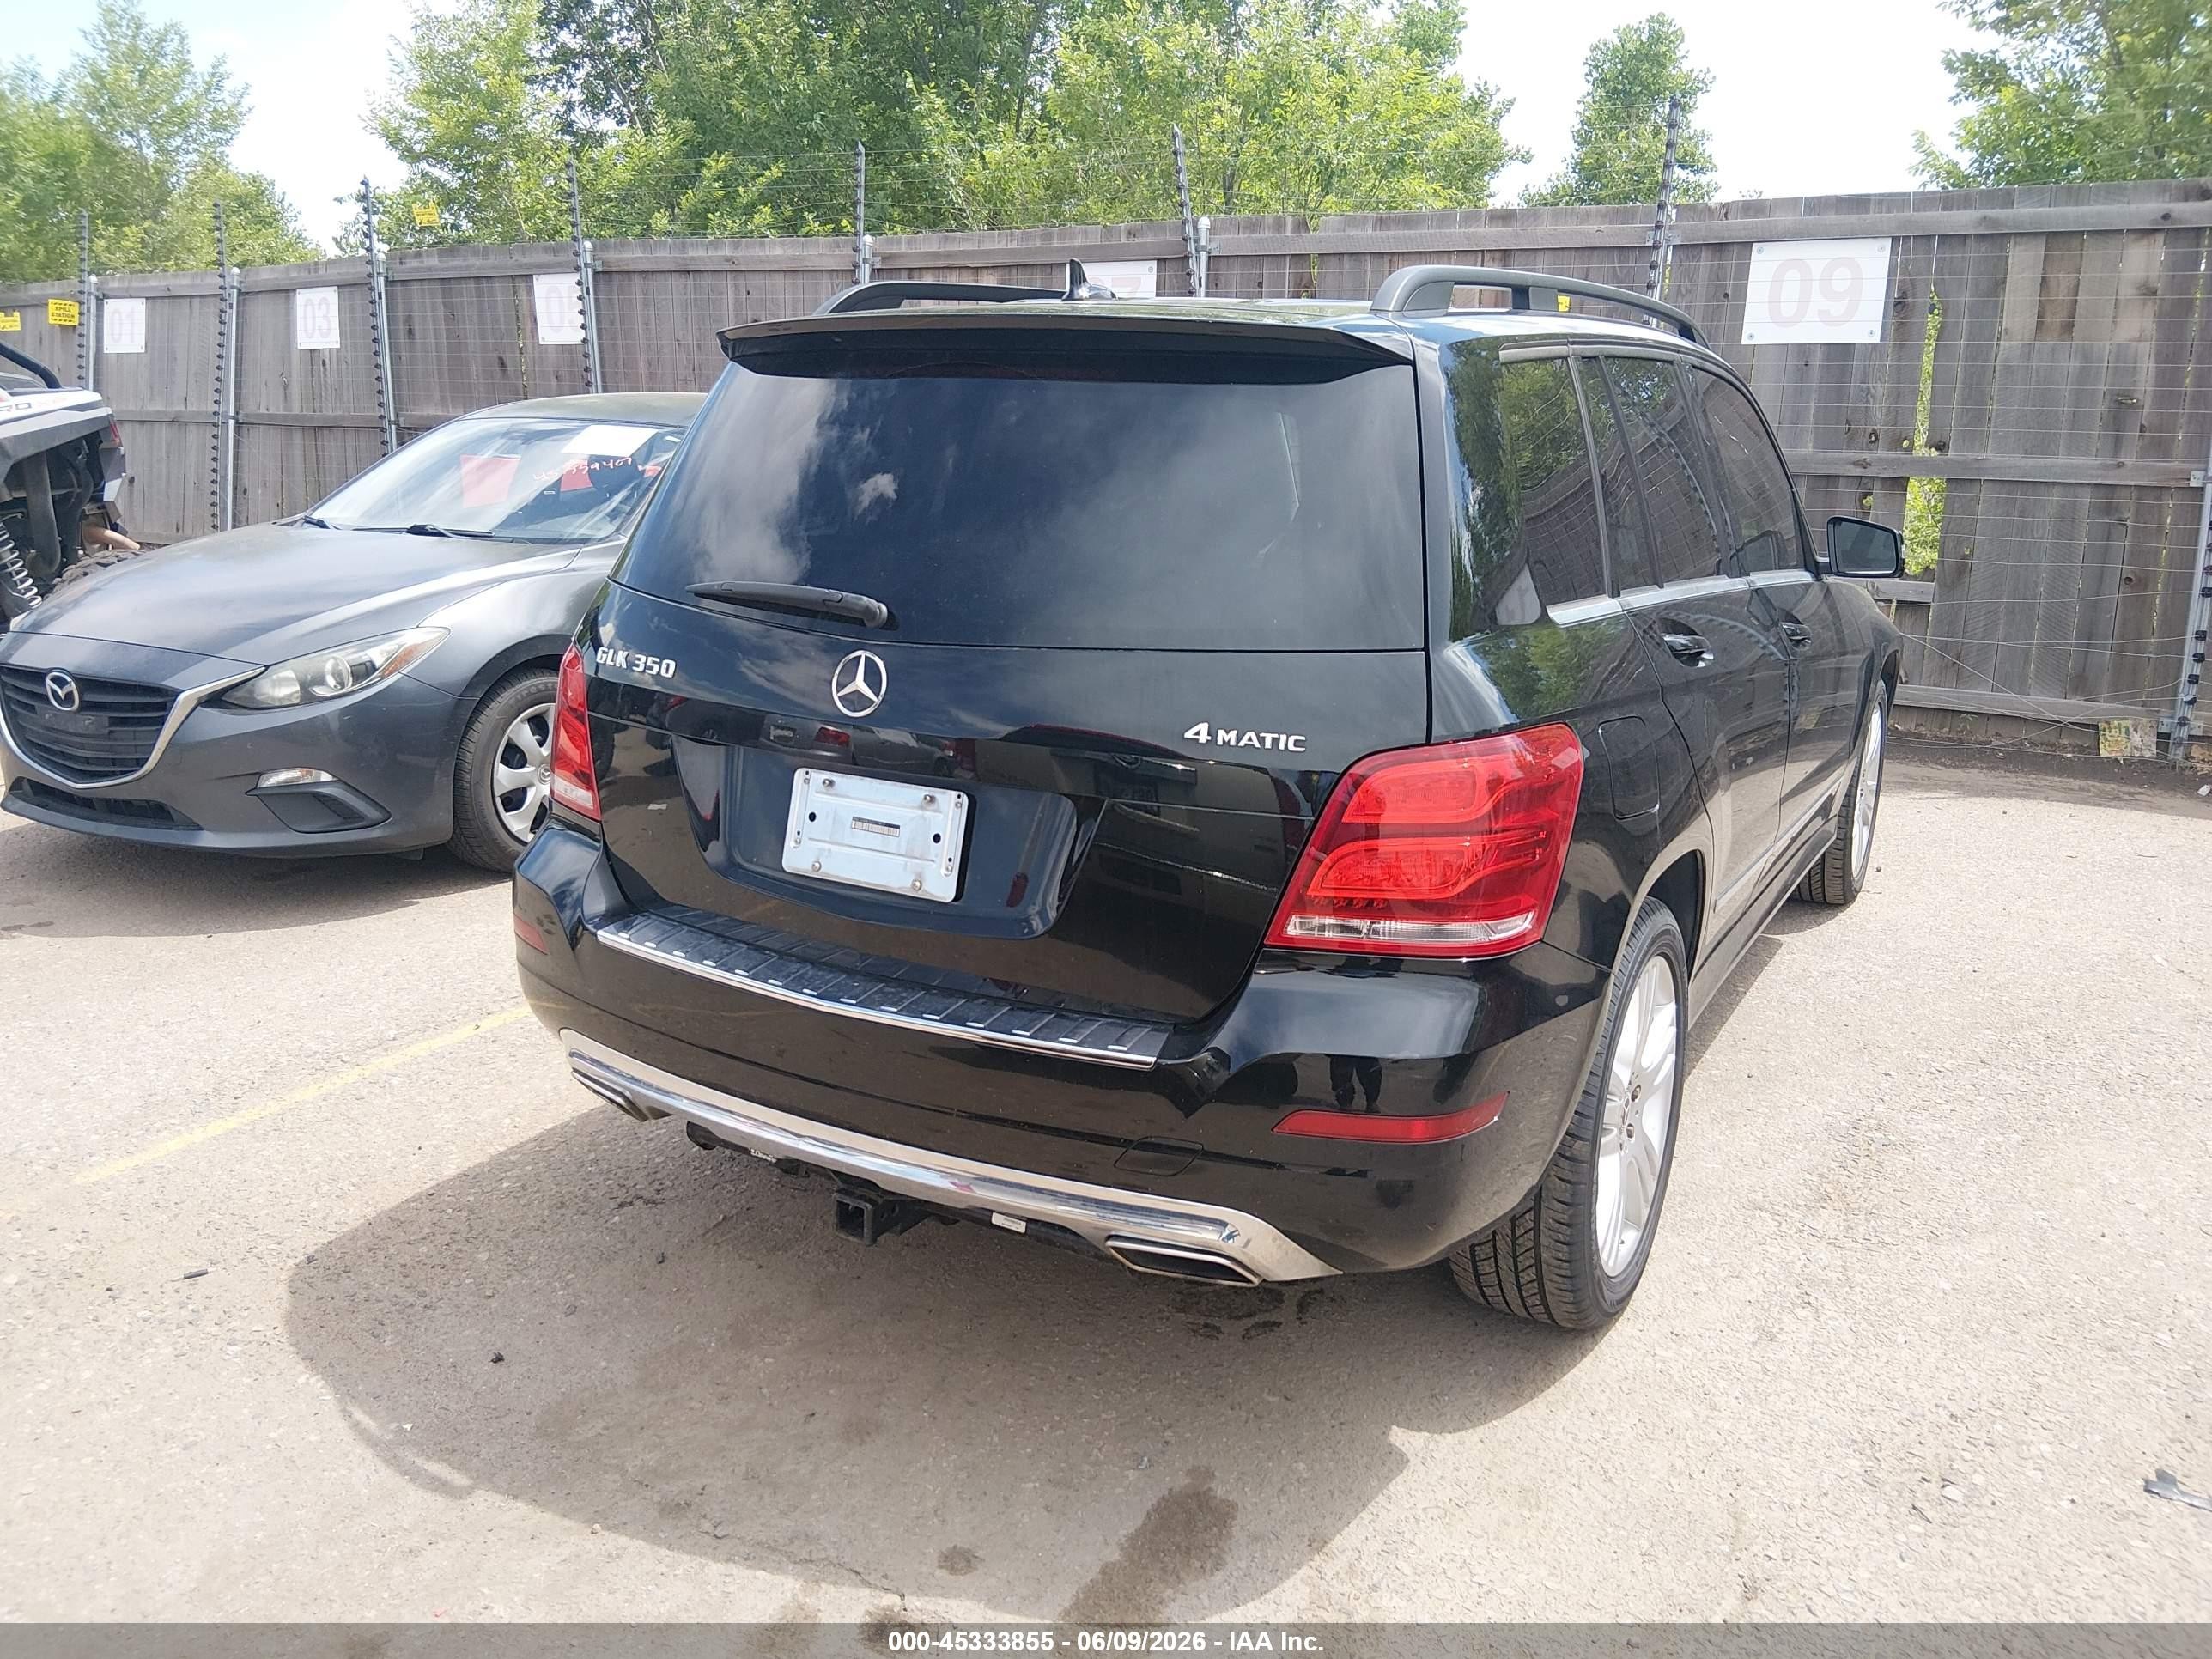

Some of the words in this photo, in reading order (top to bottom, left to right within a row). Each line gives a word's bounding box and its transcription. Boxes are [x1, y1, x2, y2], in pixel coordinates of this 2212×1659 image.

[1768, 257, 1863, 328] 09
[110, 307, 136, 343] 01
[302, 296, 331, 339] 03
[596, 647, 629, 669] GLK
[632, 653, 677, 678] 350
